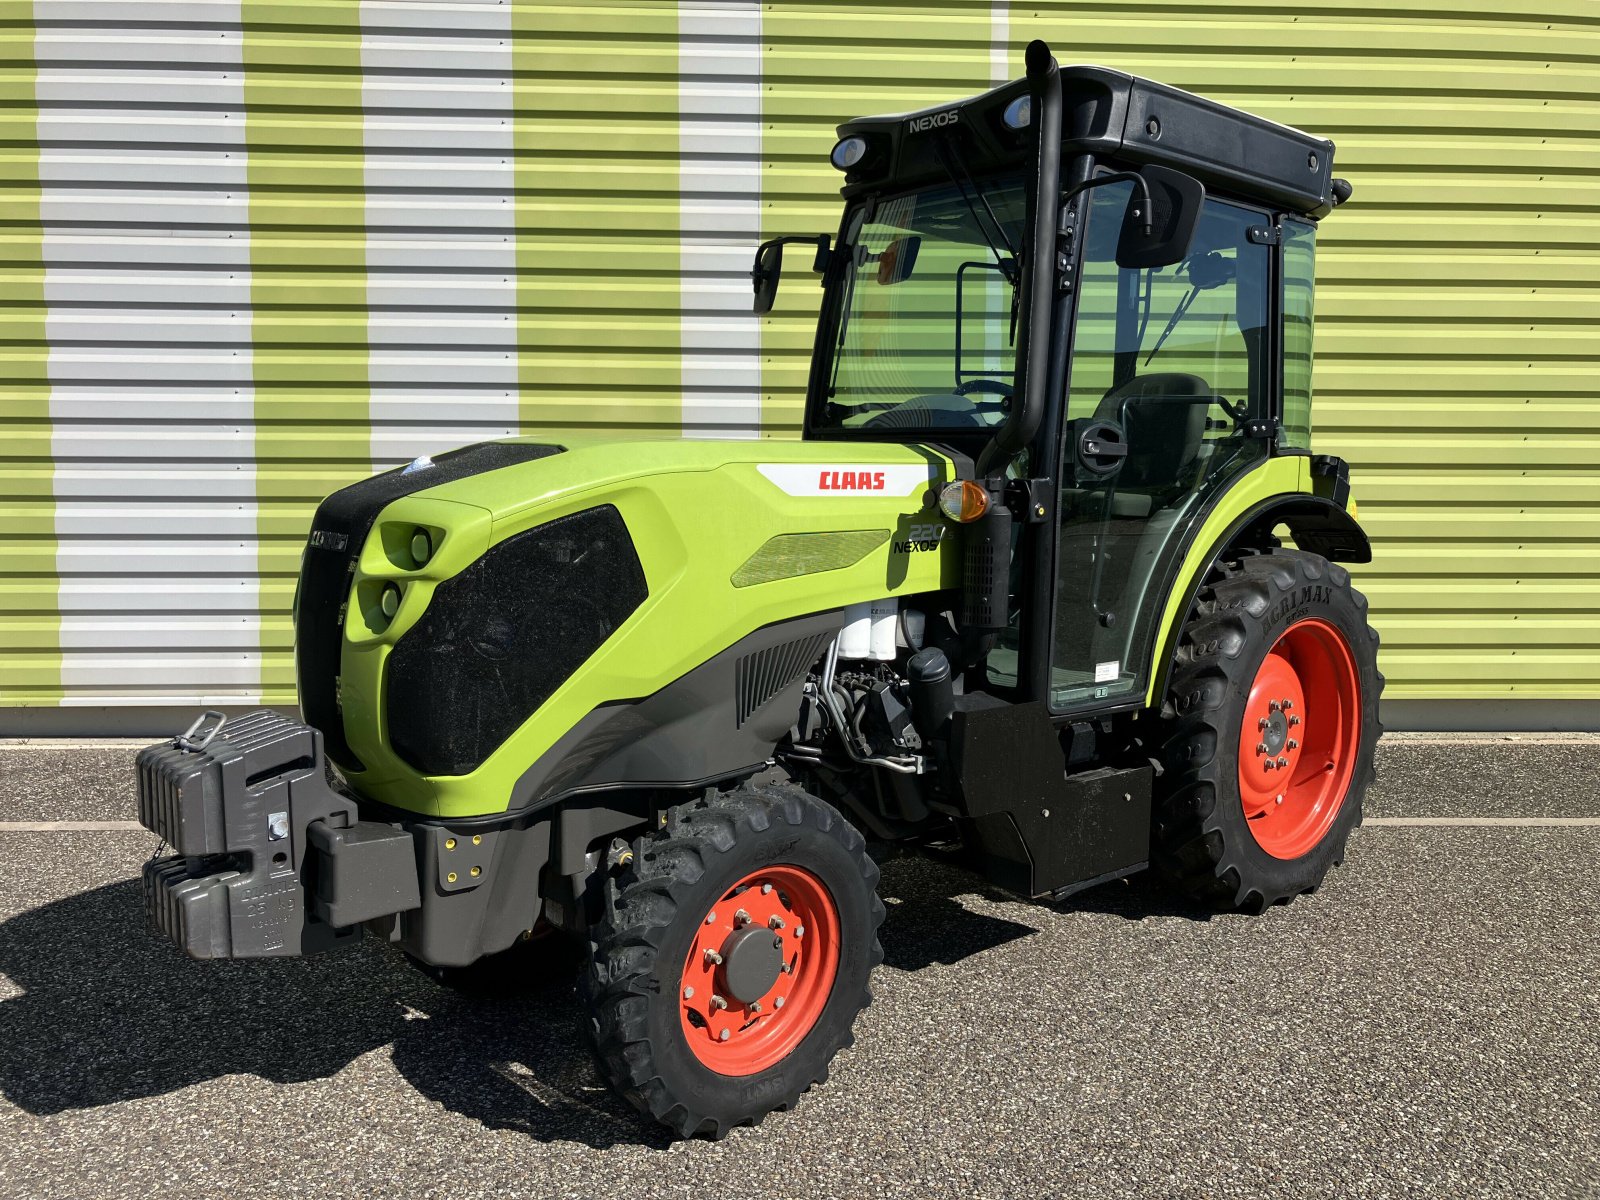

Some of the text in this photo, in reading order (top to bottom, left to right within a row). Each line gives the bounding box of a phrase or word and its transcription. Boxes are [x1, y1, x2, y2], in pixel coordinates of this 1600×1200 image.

[909, 109, 959, 133] NEXOS
[819, 471, 885, 490] CLAAS
[909, 523, 946, 541] 220
[893, 539, 938, 554] NEXOS
